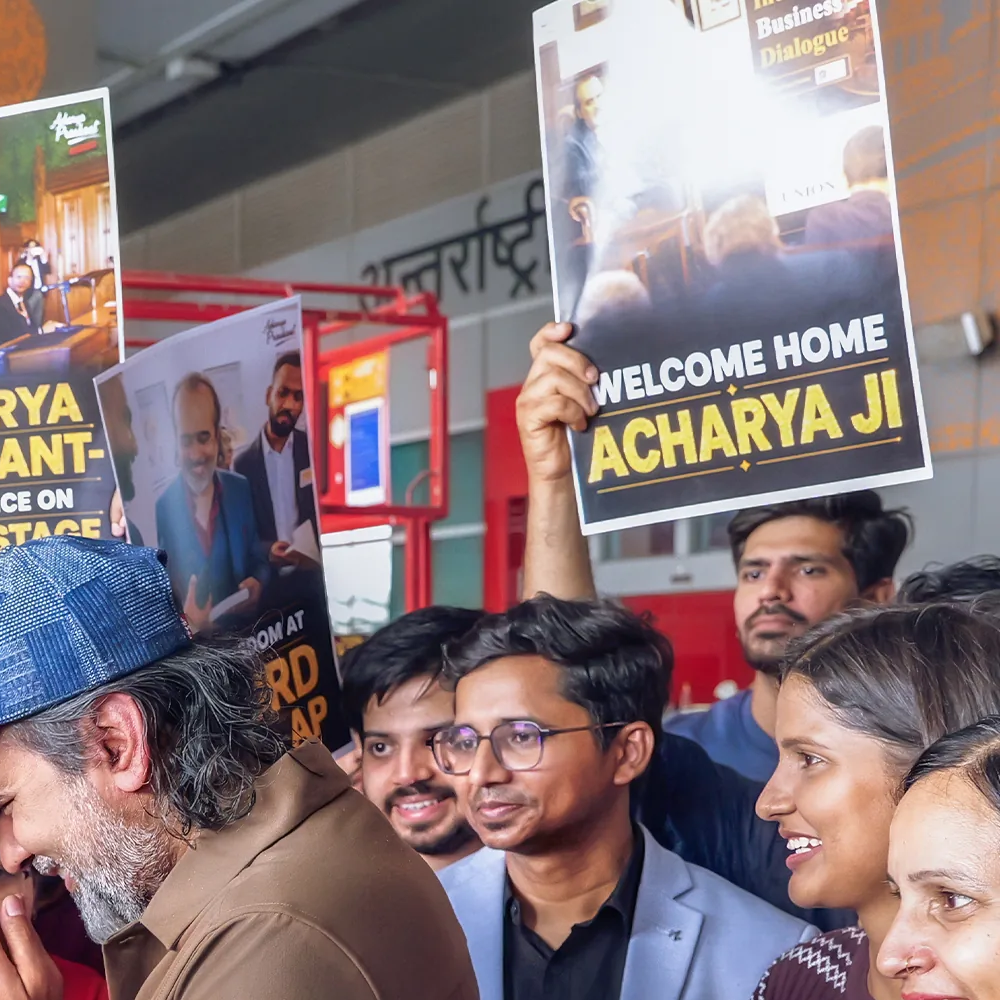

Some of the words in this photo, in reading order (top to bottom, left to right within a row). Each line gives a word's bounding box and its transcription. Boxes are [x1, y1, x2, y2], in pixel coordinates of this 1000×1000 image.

[760, 25, 849, 69] Dialogue
[594, 339, 766, 406] WELCOME
[773, 313, 888, 370] HOME
[587, 383, 844, 484] ACHARYA
[850, 369, 903, 435] JI
[37, 488, 74, 510] ON
[286, 609, 305, 636] AT
